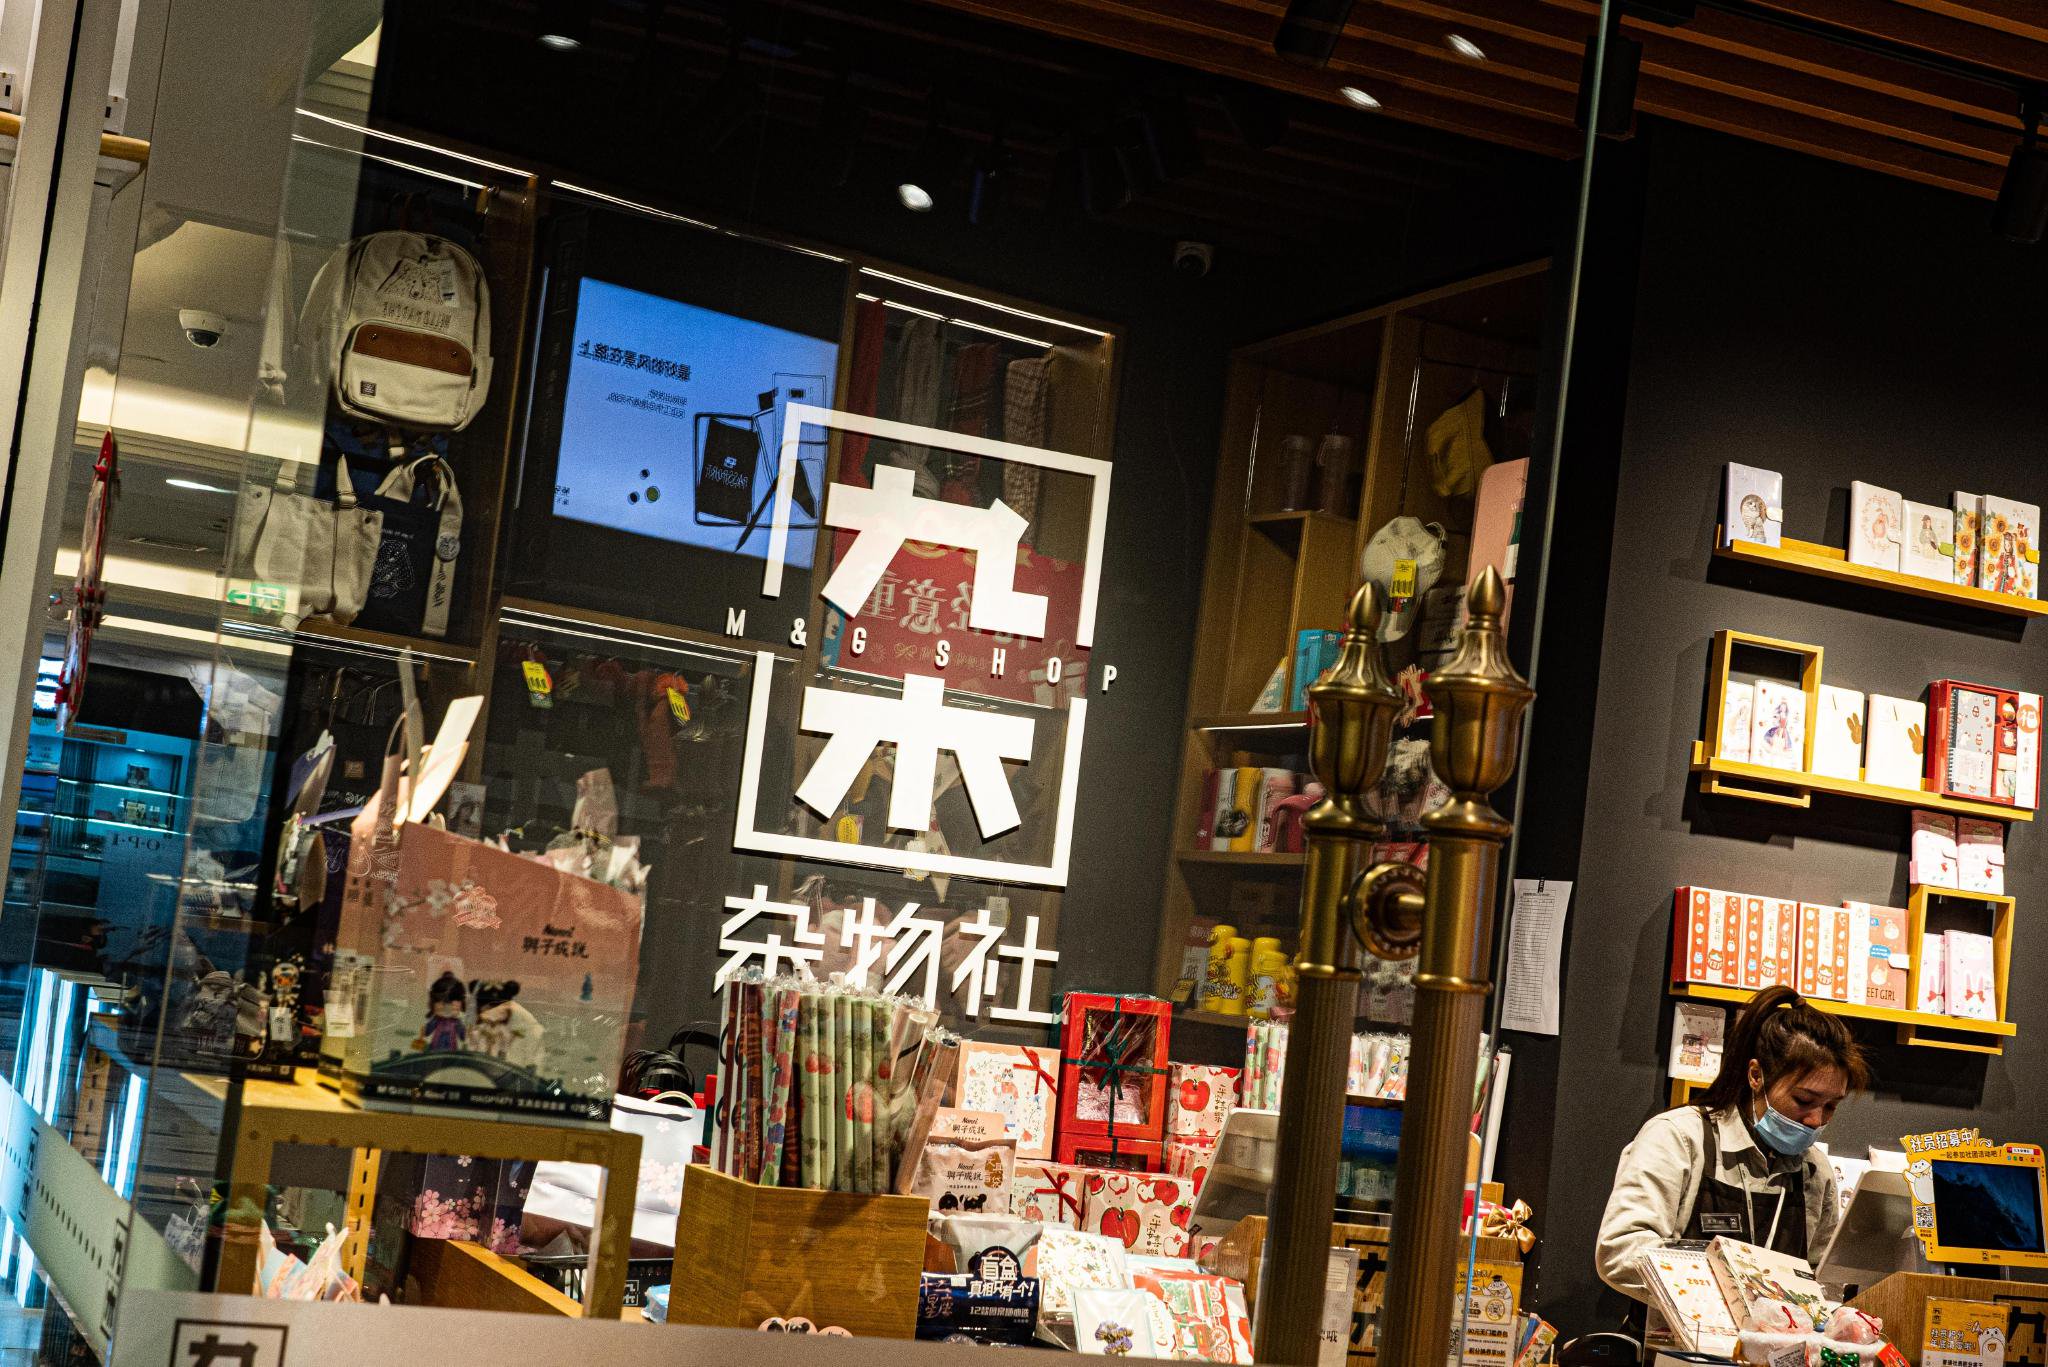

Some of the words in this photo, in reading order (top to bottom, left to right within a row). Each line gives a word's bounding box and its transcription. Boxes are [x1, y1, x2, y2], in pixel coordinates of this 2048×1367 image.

[820, 464, 1049, 639] 九
[794, 673, 1036, 839] 木
[713, 884, 1060, 1024] 杂物社
[1880, 990, 1896, 1001] GIRL
[1910, 1130, 1973, 1152] 社员招募中
[981, 1254, 1018, 1281] 盲盒
[1686, 1277, 1711, 1287] 2021
